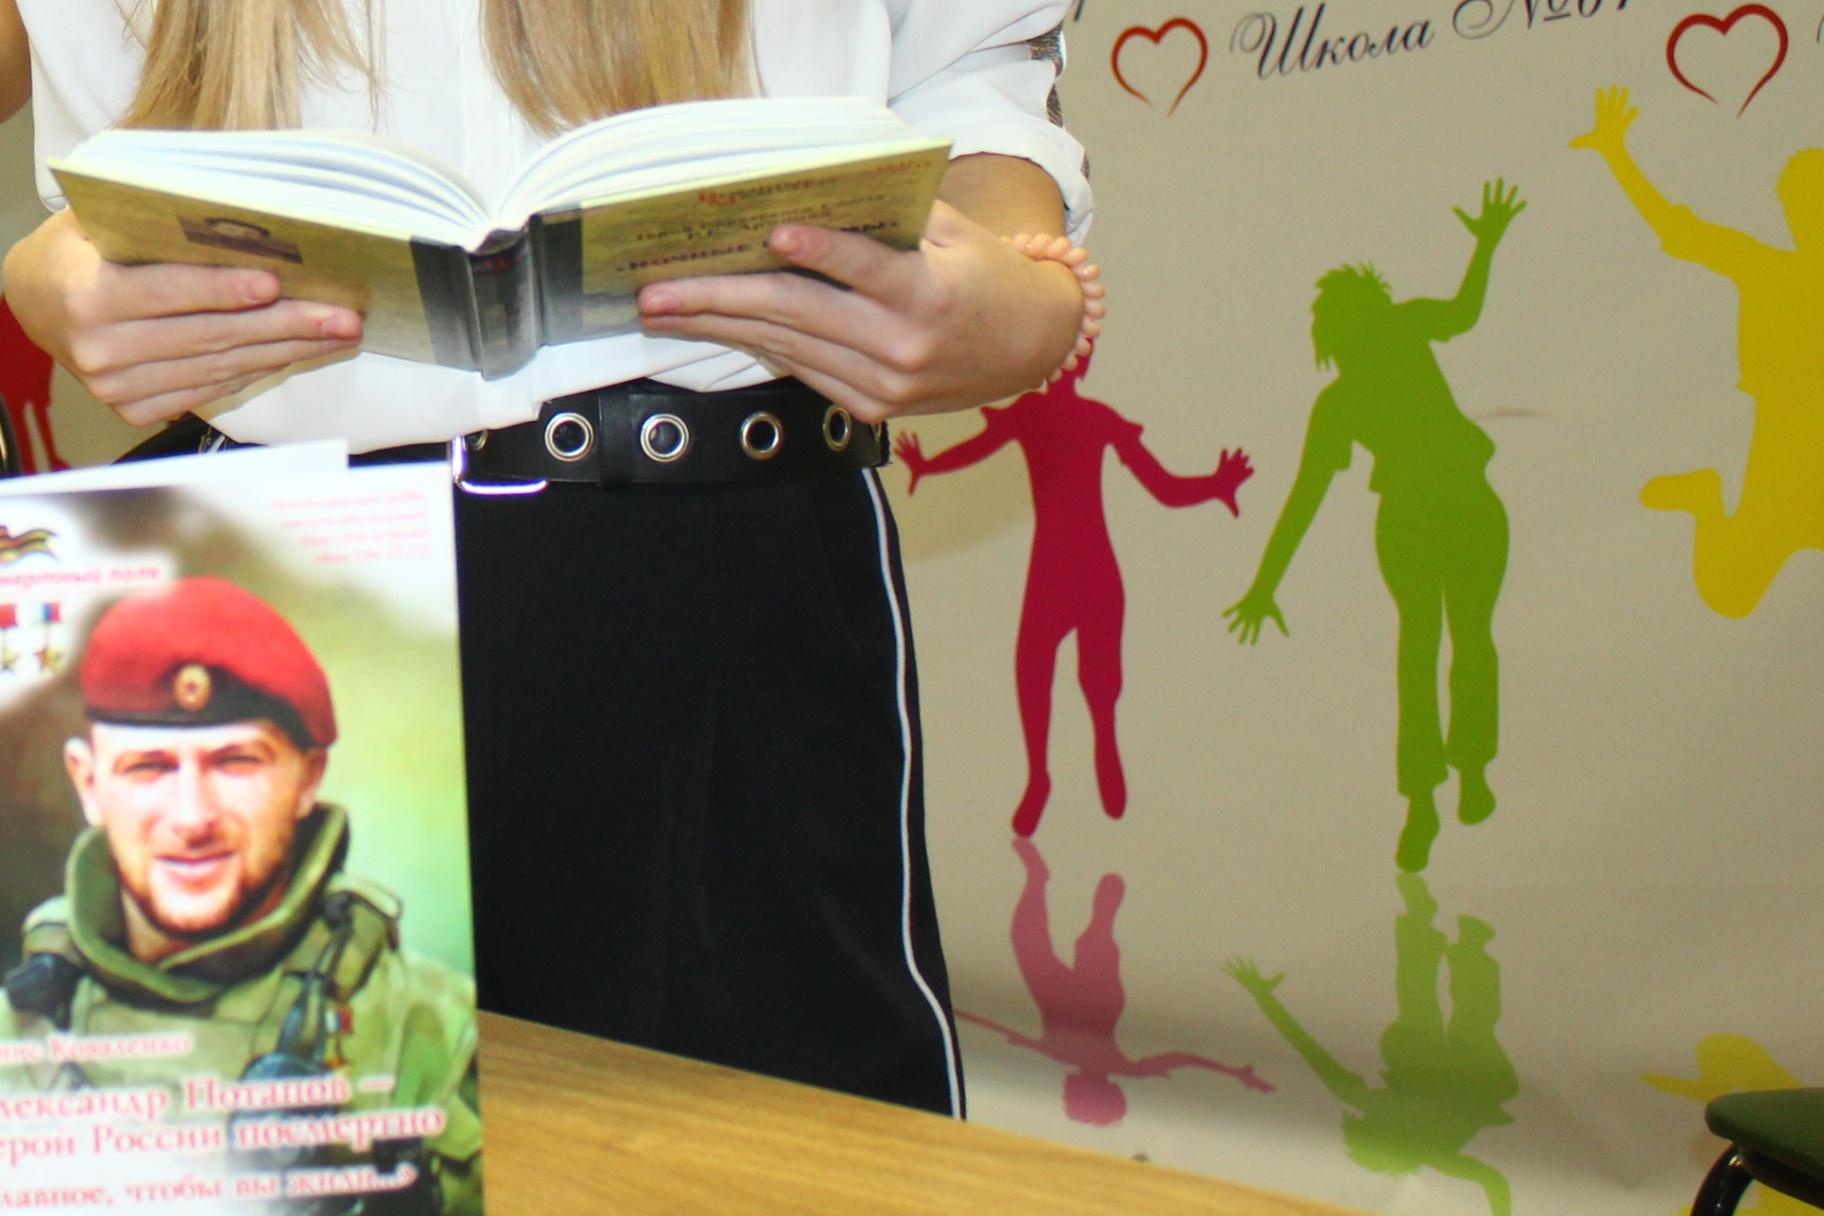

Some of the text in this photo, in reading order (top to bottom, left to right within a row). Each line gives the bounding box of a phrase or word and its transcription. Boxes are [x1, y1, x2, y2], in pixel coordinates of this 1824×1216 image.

[1229, 1, 1437, 80] Школа
[92, 1120, 224, 1155] России
[234, 1106, 447, 1152] посмертно
[124, 1173, 223, 1202] чтобы
